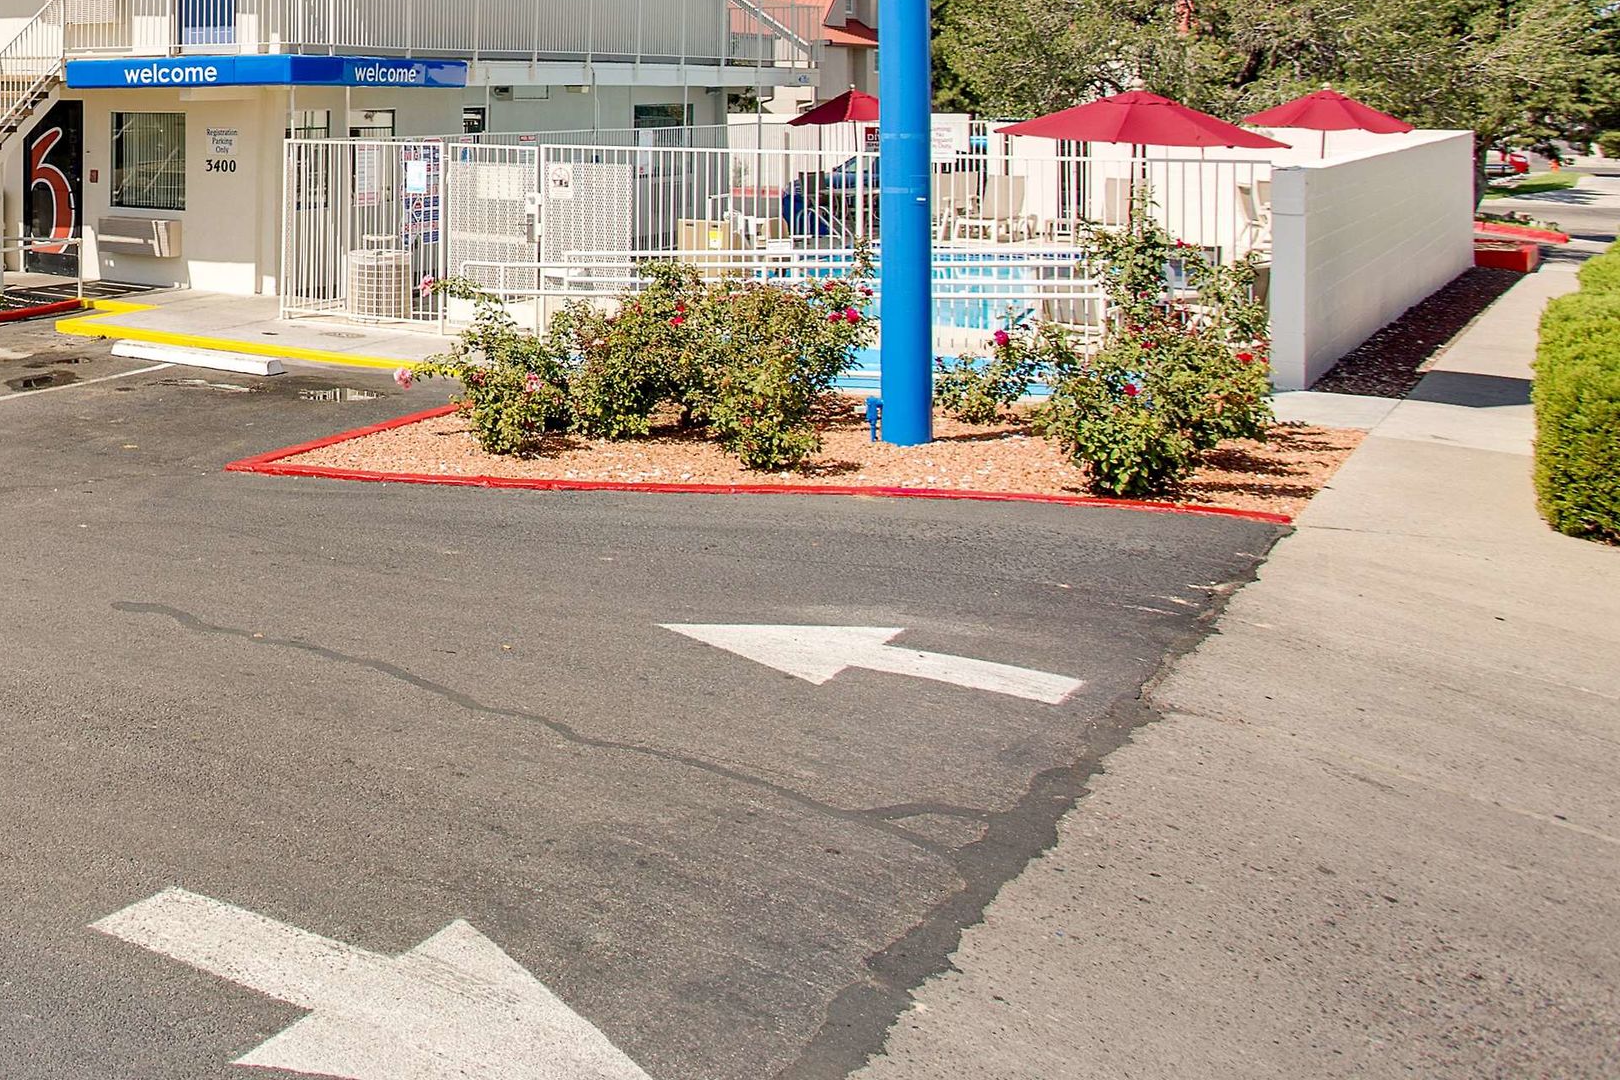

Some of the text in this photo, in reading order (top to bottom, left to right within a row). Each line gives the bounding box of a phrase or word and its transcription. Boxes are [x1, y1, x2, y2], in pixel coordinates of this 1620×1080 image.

[124, 63, 218, 84] welcome
[355, 62, 417, 83] welcome
[206, 128, 238, 137] Registration
[211, 137, 233, 146] Parking
[215, 146, 229, 154] Only
[205, 159, 237, 172] 3400
